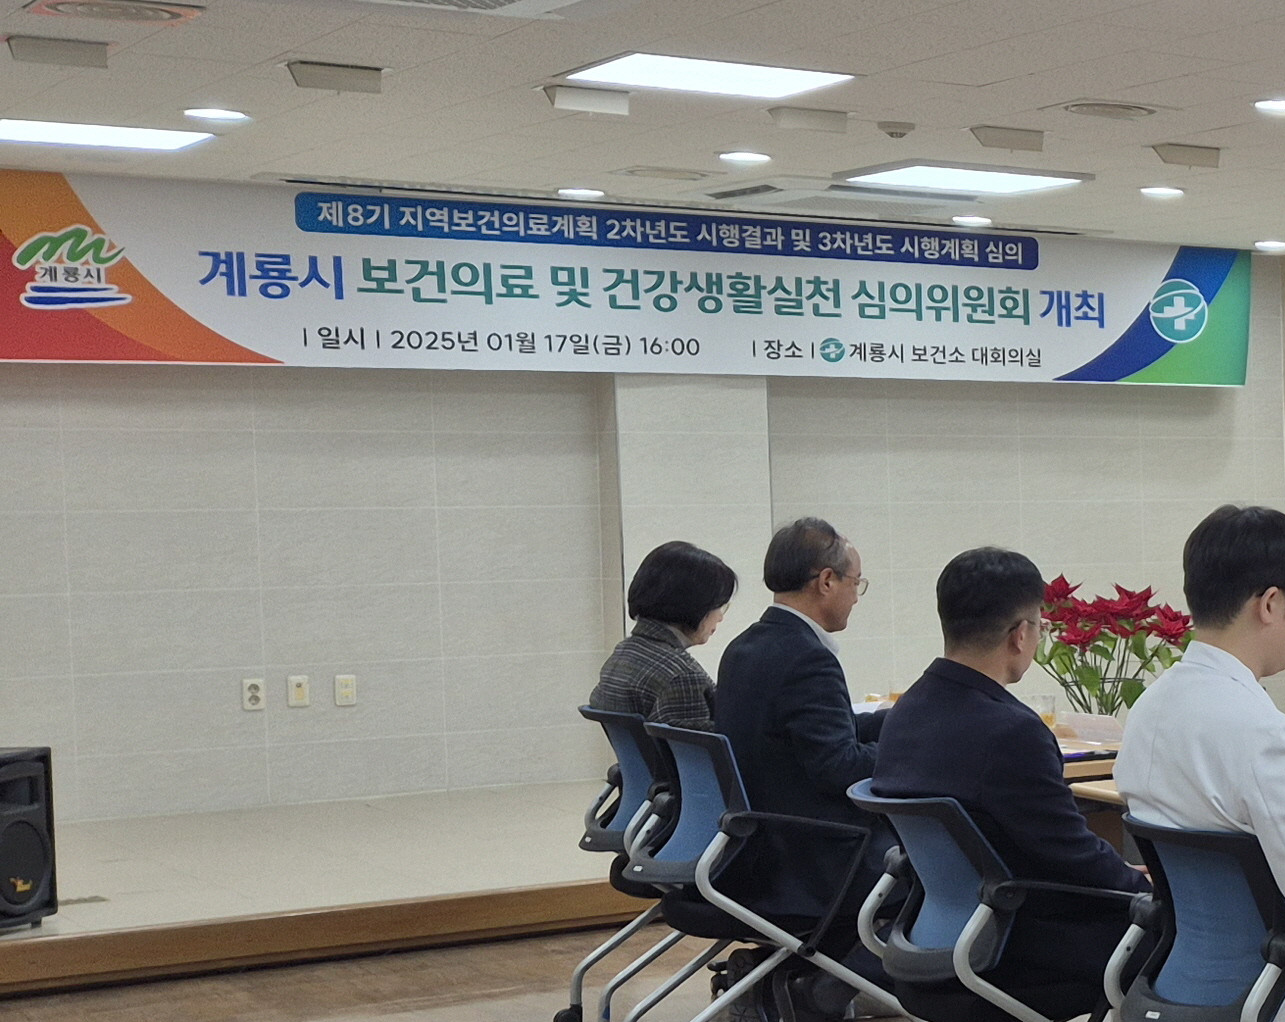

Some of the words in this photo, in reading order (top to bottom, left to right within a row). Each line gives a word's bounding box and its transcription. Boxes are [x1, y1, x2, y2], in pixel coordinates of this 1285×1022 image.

[317, 201, 391, 230] 제8기
[399, 204, 599, 240] 지역보건의료계획
[605, 218, 691, 243] 2차년도
[696, 222, 785, 250] 시행결과
[790, 230, 811, 251] 및
[818, 231, 895, 255] 3차년도
[900, 234, 979, 262] 시행계획
[985, 243, 1023, 264] 심의
[39, 266, 102, 284] 계룡시
[198, 250, 344, 300] 계룡시
[357, 257, 540, 305] 보건의료
[550, 265, 592, 309] 및
[602, 267, 842, 318] 건강생활실천
[851, 280, 1030, 325] 심의위원회
[1039, 288, 1105, 328] 개최
[317, 326, 365, 350] 일시
[390, 329, 479, 353] 2025년
[487, 331, 537, 354] 01월
[544, 333, 632, 356] 17일(금)
[640, 336, 700, 356] 16:00
[763, 340, 803, 360] 장소
[849, 342, 904, 364] 계룡시
[911, 345, 966, 365] 보건소
[972, 347, 1042, 368] 대회의실
